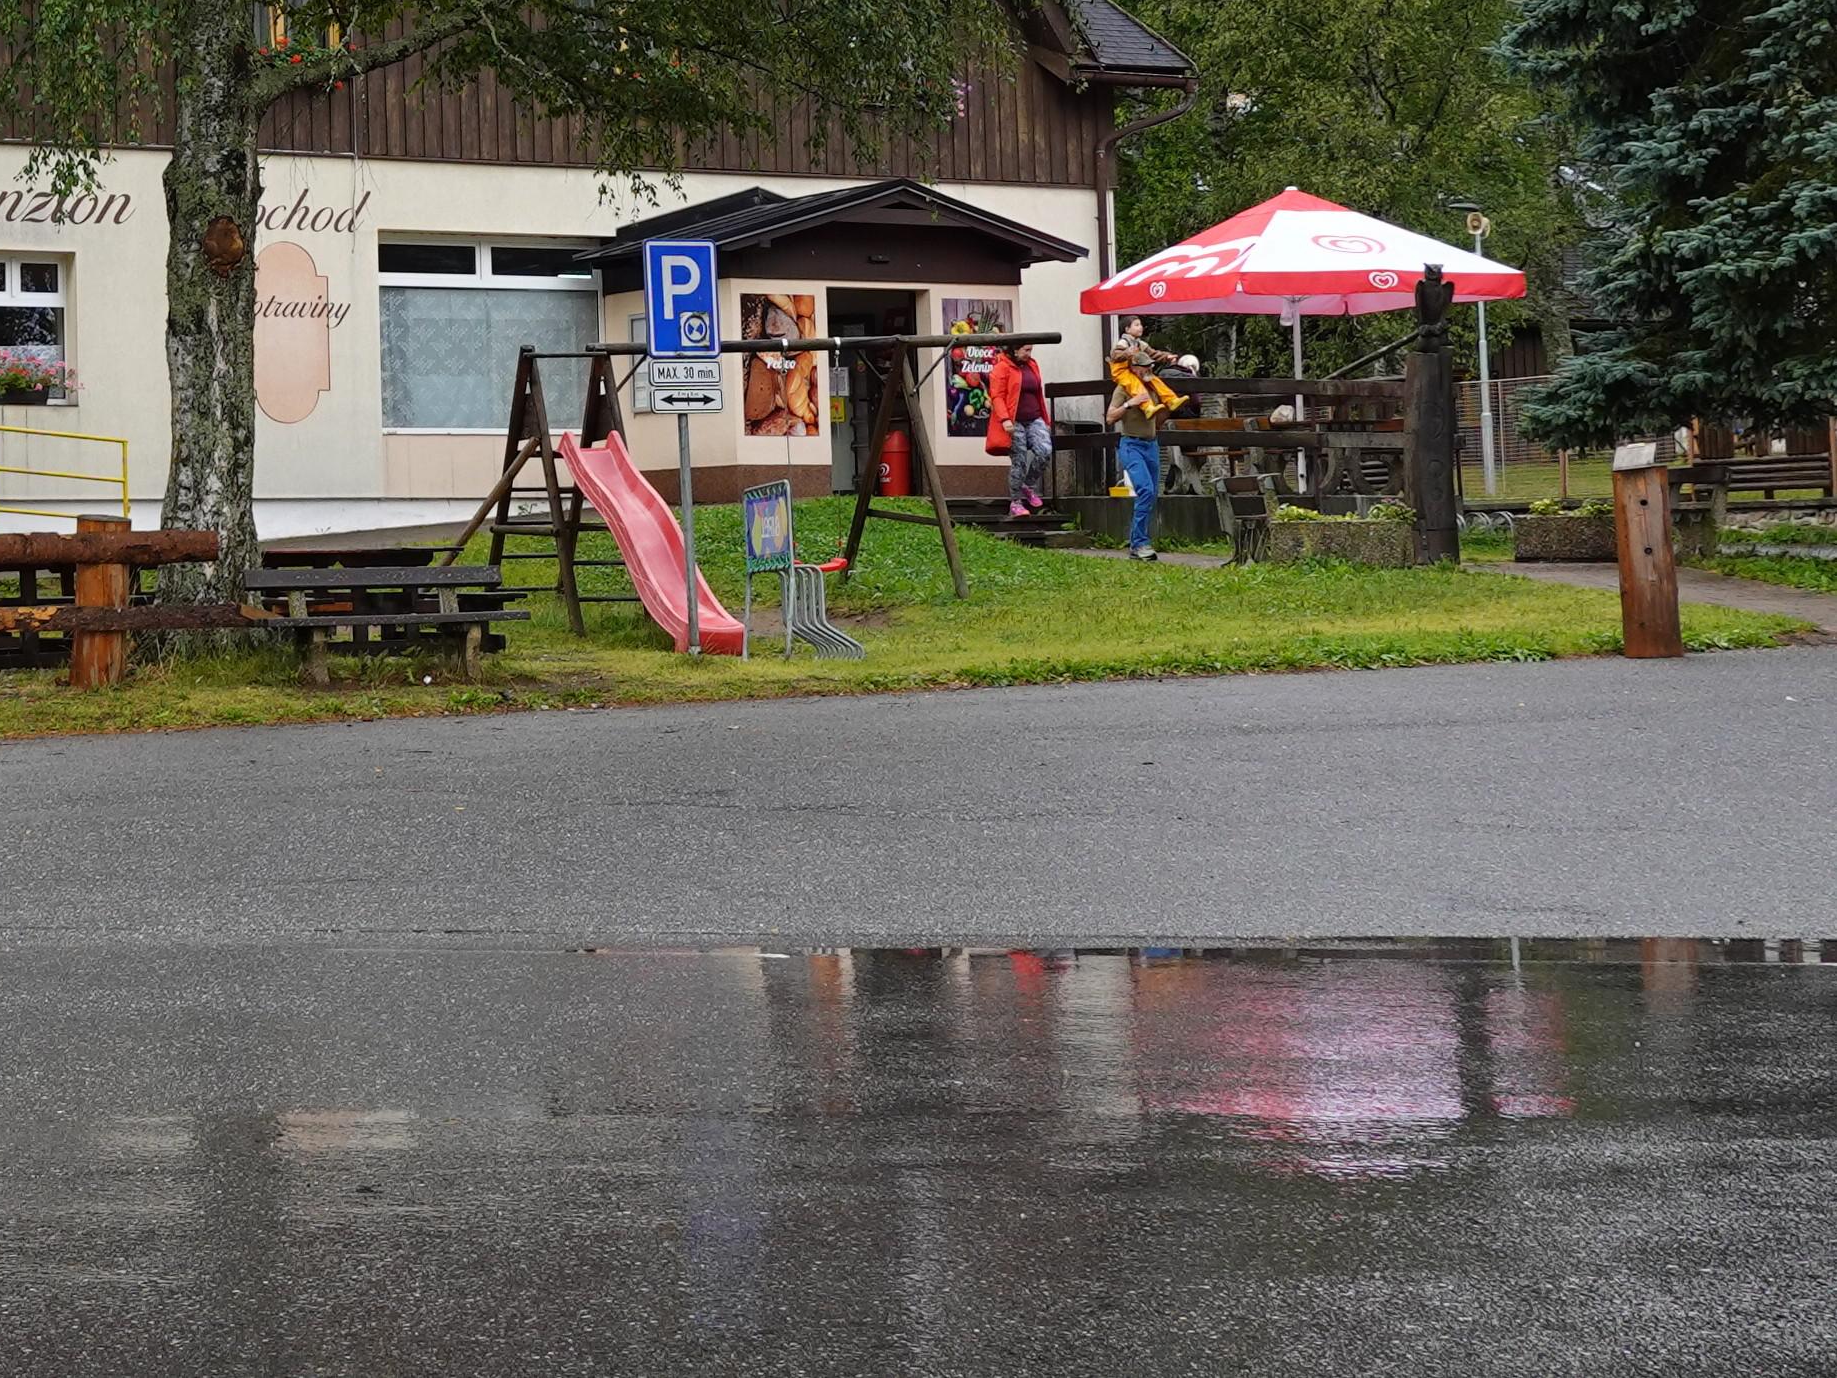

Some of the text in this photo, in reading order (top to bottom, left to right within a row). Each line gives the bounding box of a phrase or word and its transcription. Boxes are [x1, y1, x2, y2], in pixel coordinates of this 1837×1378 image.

[255, 188, 371, 233] chod
[661, 255, 701, 320] P
[253, 294, 351, 330] otraviny
[657, 366, 716, 380] MAX. 30 min.
